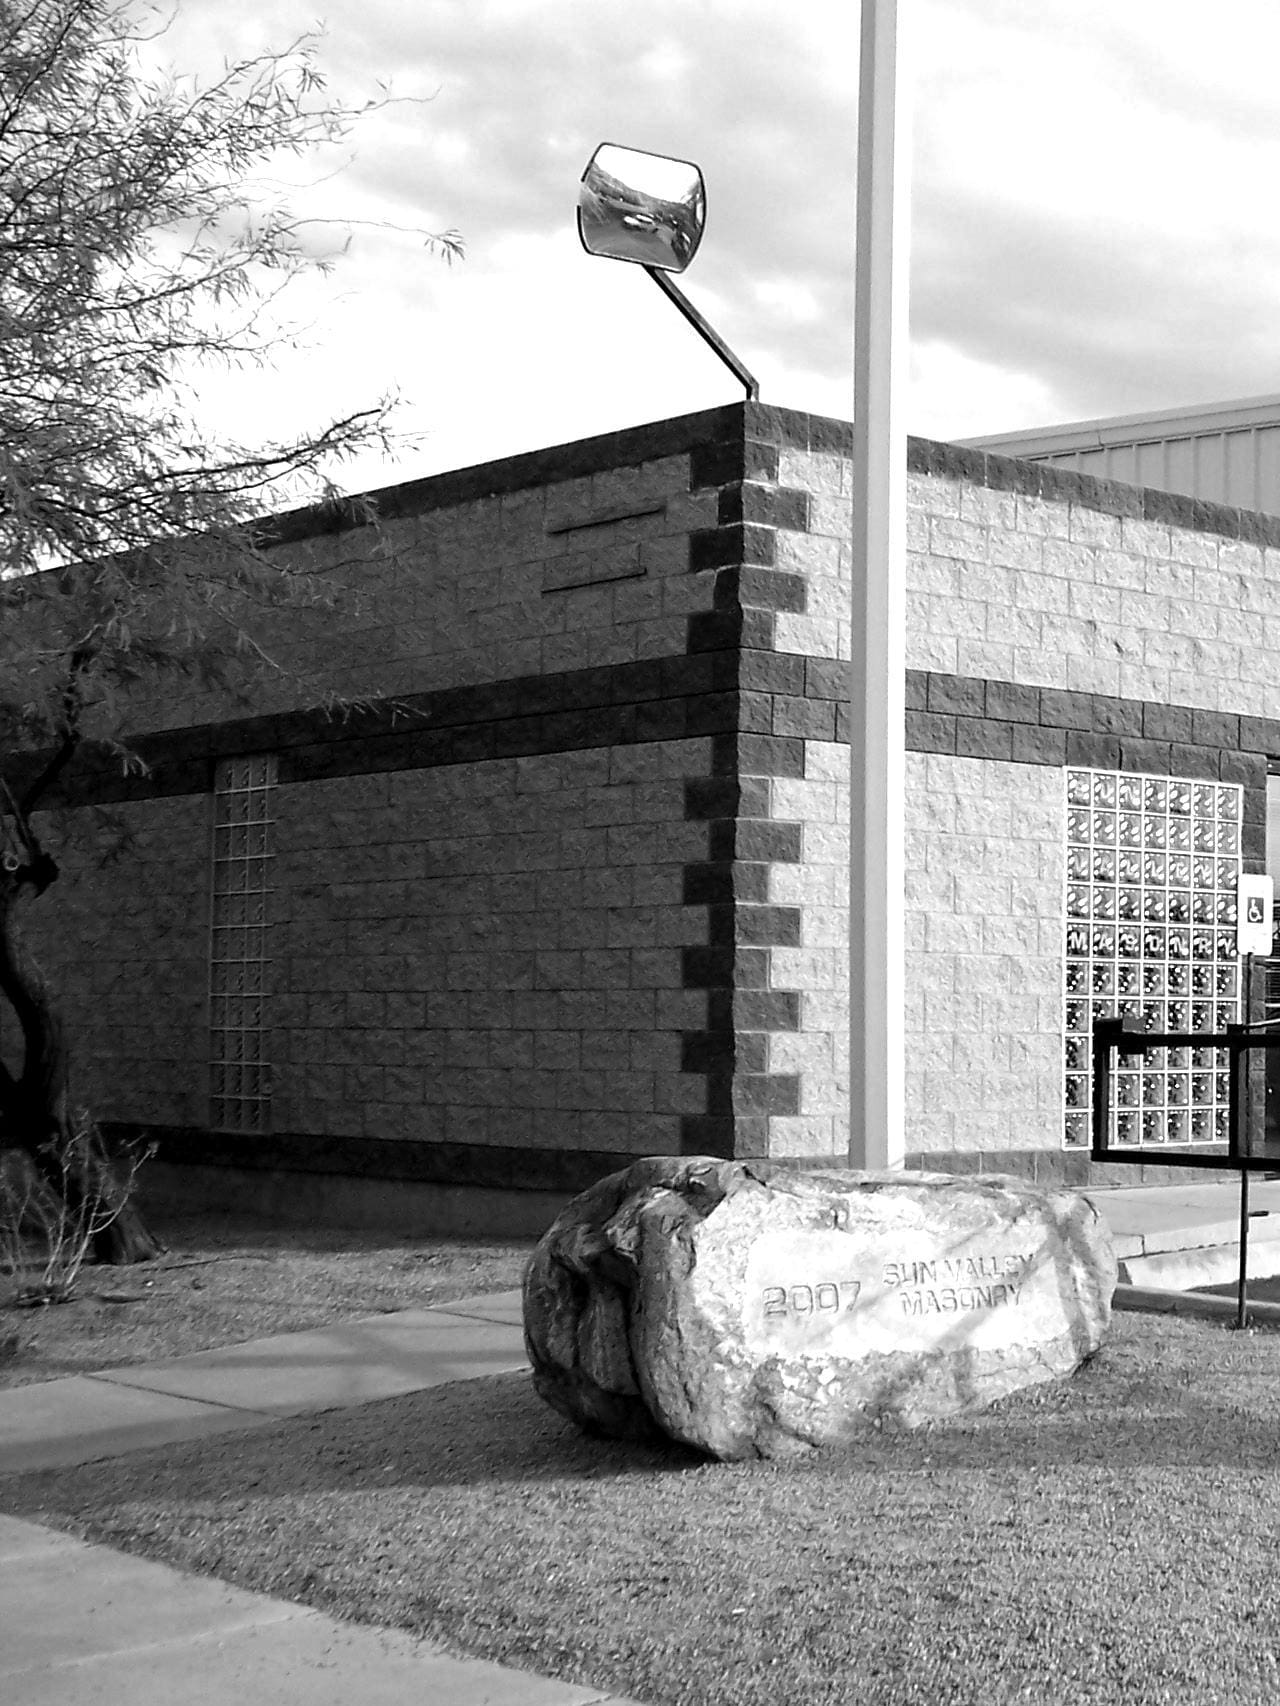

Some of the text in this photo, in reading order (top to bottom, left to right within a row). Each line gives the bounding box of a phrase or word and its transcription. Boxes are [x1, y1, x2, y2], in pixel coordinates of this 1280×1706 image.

[1069, 931, 1233, 955] MASONRY
[883, 1253, 1034, 1287] SUN VALLEY
[762, 1280, 861, 1317] 2007
[900, 1283, 1026, 1316] MASONRY
